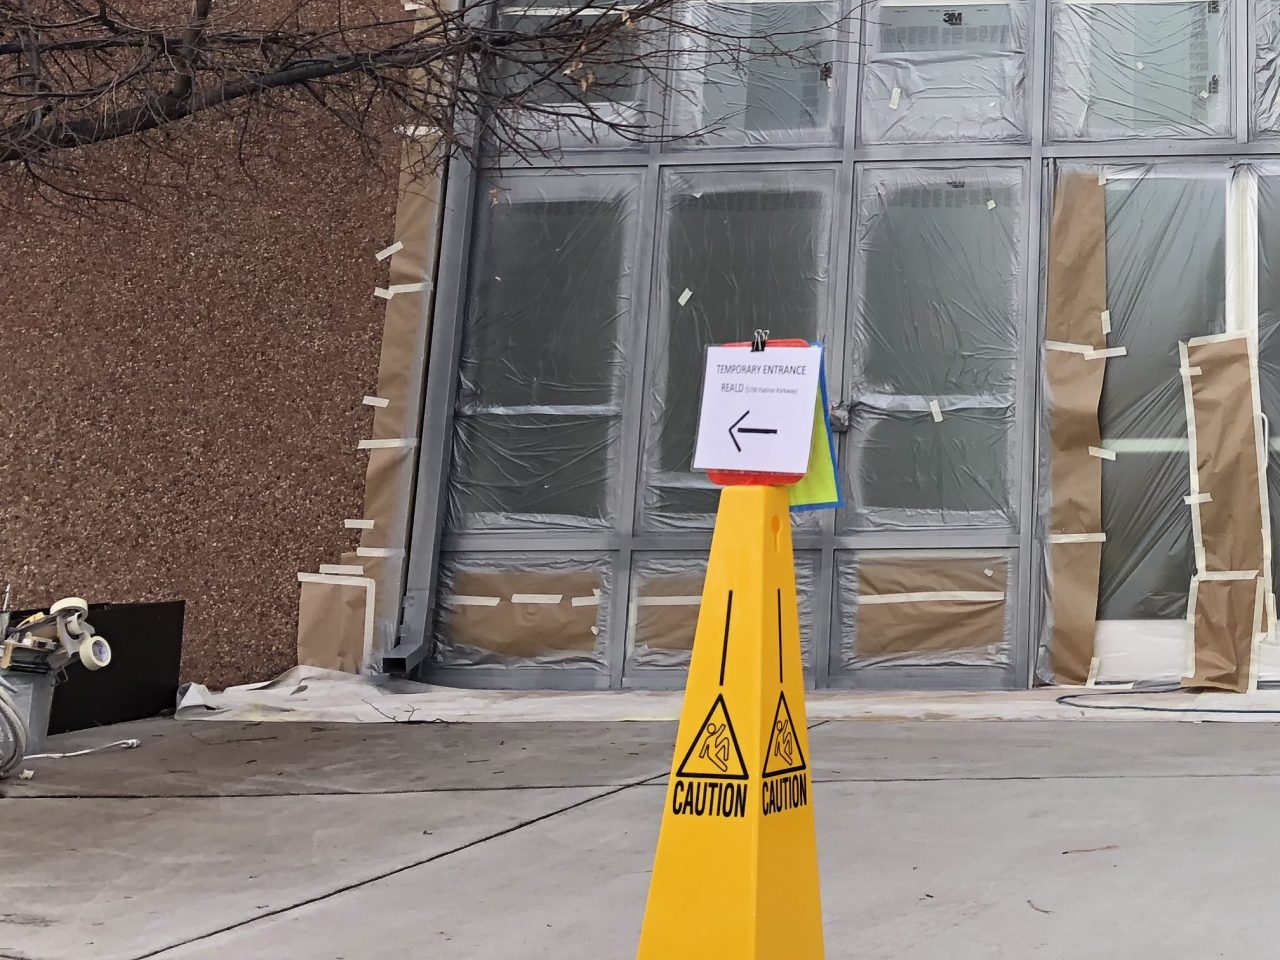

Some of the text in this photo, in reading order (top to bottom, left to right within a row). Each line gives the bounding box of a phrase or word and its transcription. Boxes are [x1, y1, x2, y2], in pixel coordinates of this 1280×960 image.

[943, 13, 962, 23] 3M
[716, 364, 807, 376] TEMPORARY ENTRANCE
[721, 383, 745, 393] REALD
[672, 780, 748, 818] CAUTION
[762, 773, 808, 817] CAUTION
